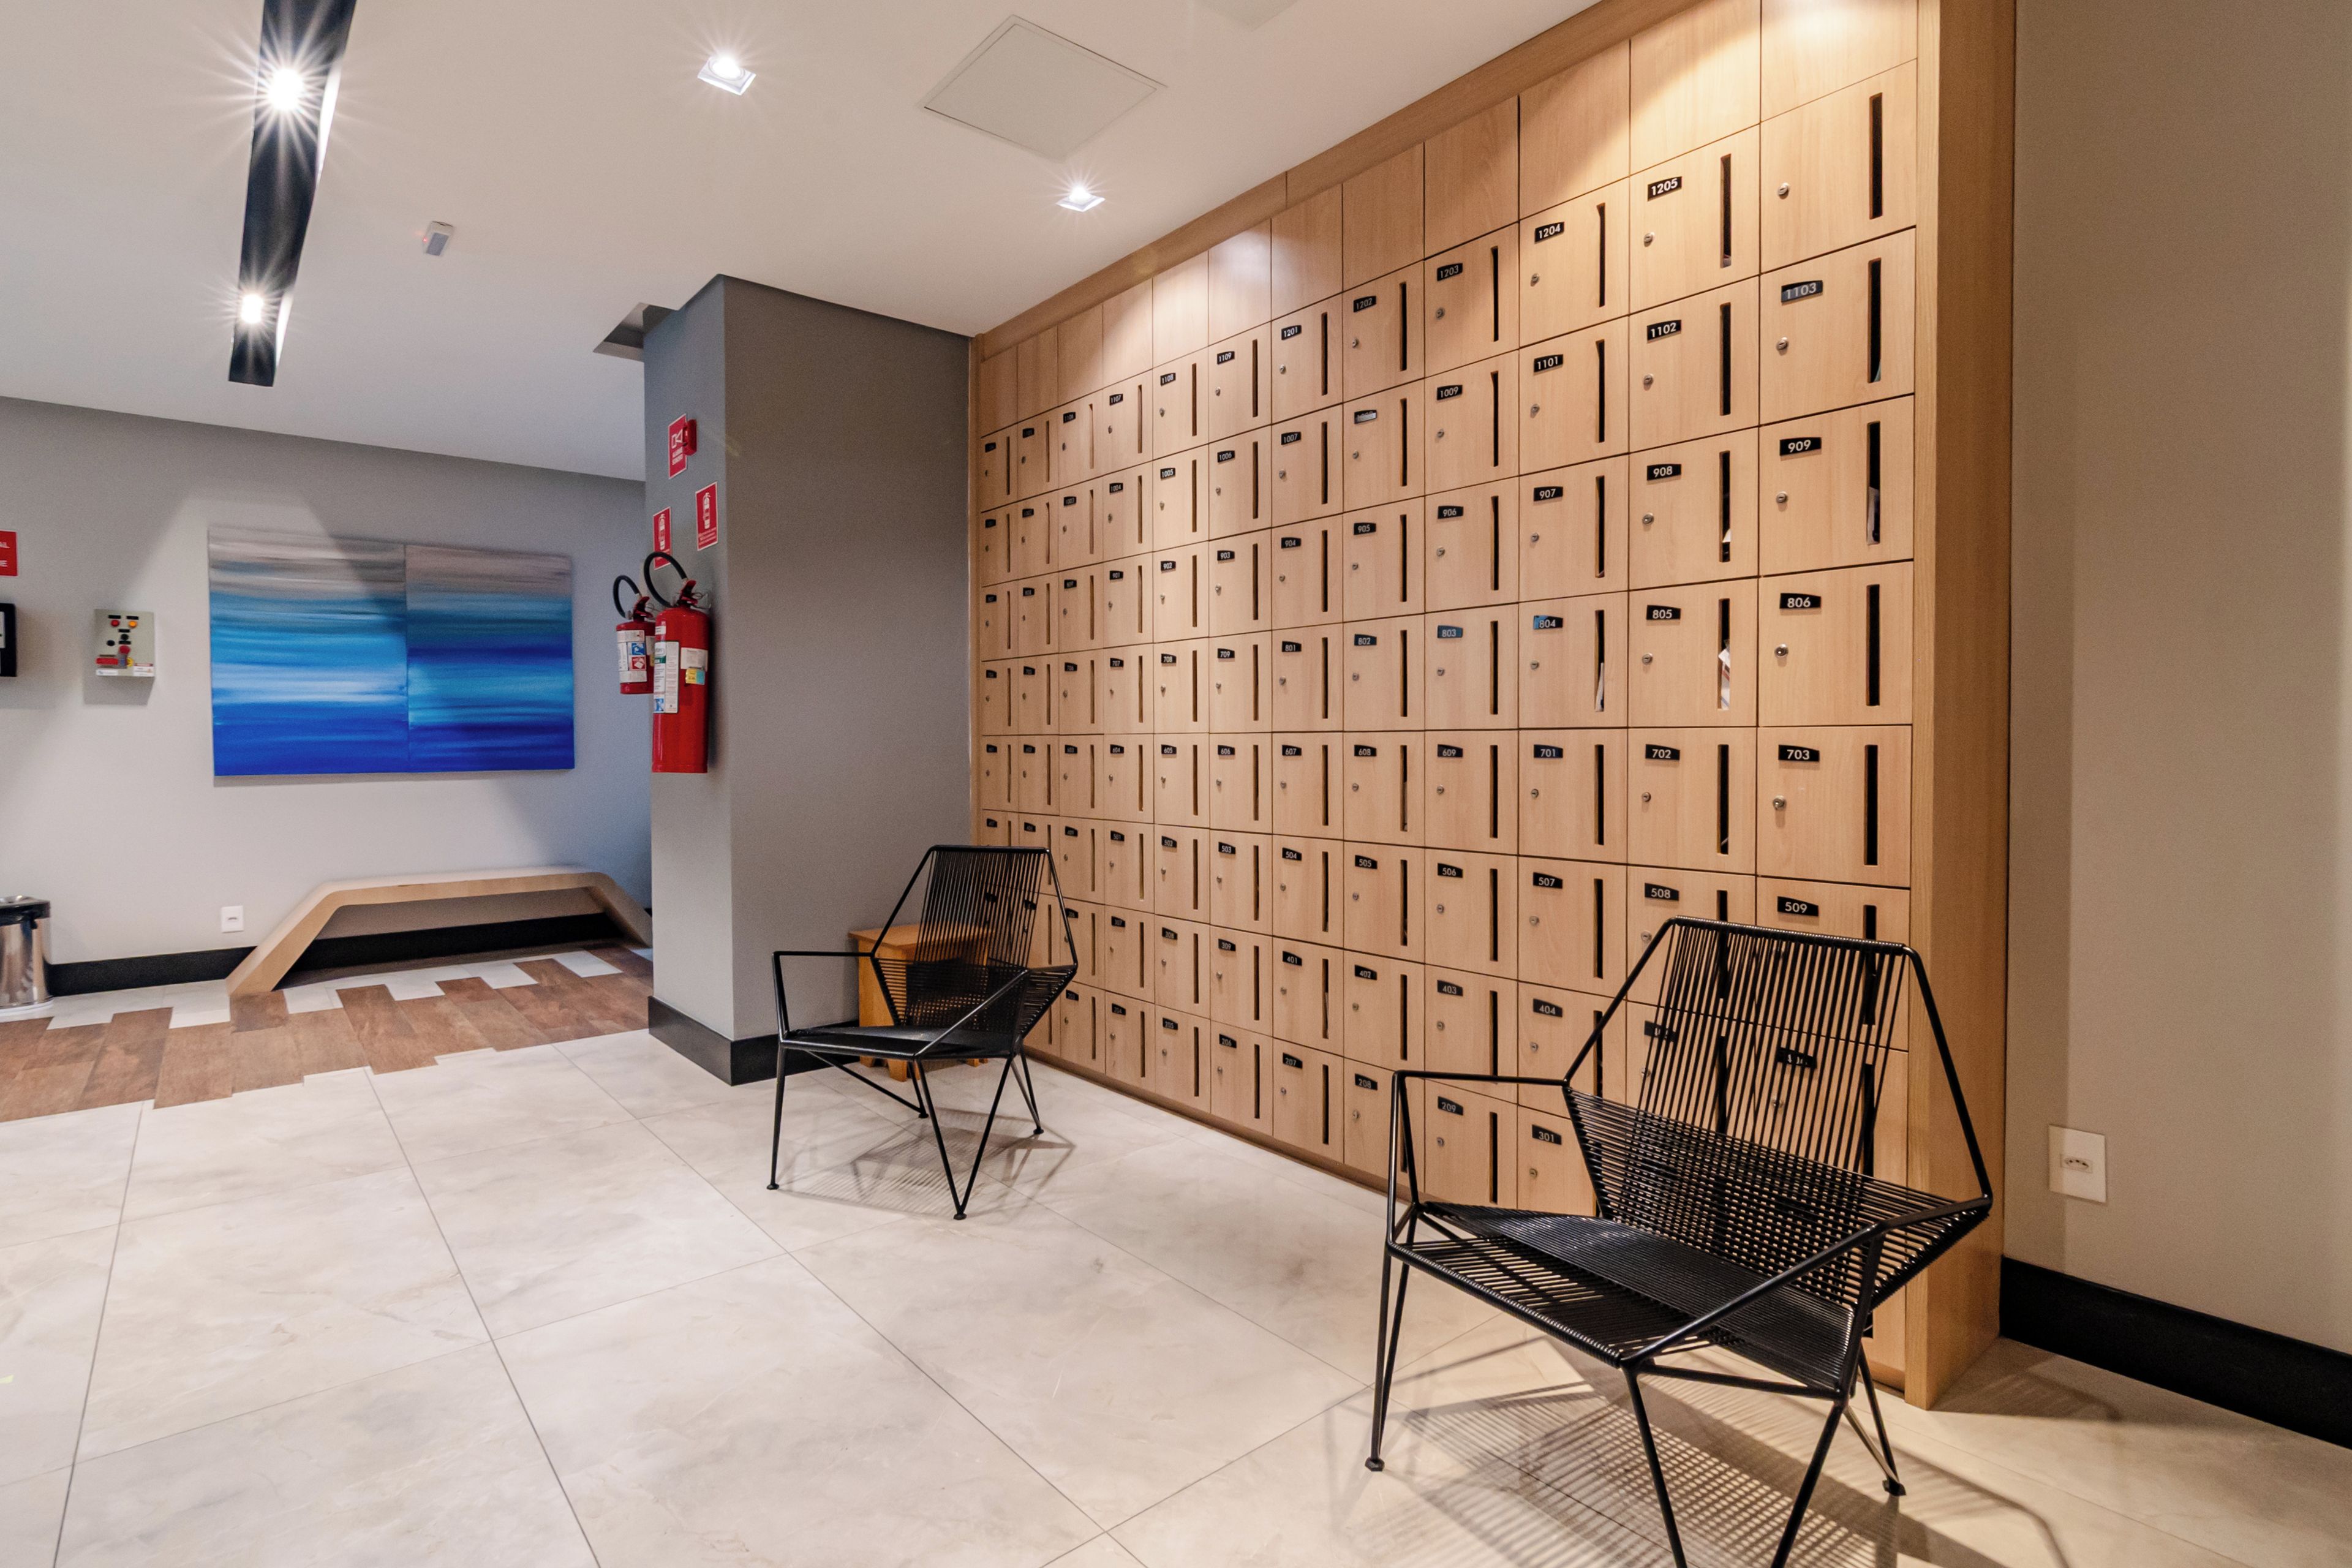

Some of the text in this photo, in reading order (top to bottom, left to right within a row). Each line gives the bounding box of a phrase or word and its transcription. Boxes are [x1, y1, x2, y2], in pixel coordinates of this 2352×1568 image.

[1652, 179, 1678, 195] 1205
[1539, 224, 1561, 238] 1204
[1441, 265, 1459, 278] 1203
[1787, 283, 1816, 299] 1103
[1356, 298, 1372, 310] 1202
[1284, 327, 1297, 337] 1201
[1651, 323, 1676, 337] 1102
[1219, 353, 1232, 362] 1109
[1537, 356, 1558, 369] 1101
[1441, 386, 1458, 398] 1009
[1284, 434, 1298, 443] 1007
[1789, 440, 1811, 453] 909
[1654, 466, 1673, 477] 908
[1540, 489, 1556, 499] 907
[1787, 597, 1811, 608] 806
[1653, 609, 1672, 619] 805
[1539, 619, 1555, 628] 804
[1653, 749, 1671, 758] 702
[1787, 750, 1809, 760] 703
[1359, 859, 1371, 867] 505
[1539, 877, 1555, 886] 507
[1651, 888, 1671, 899] 508
[1785, 902, 1807, 913] 509
[1442, 986, 1457, 995] 403
[1539, 1005, 1555, 1014] 404
[1359, 1079, 1371, 1088] 208
[1442, 1102, 1457, 1112] 209
[1539, 1131, 1554, 1142] 301
